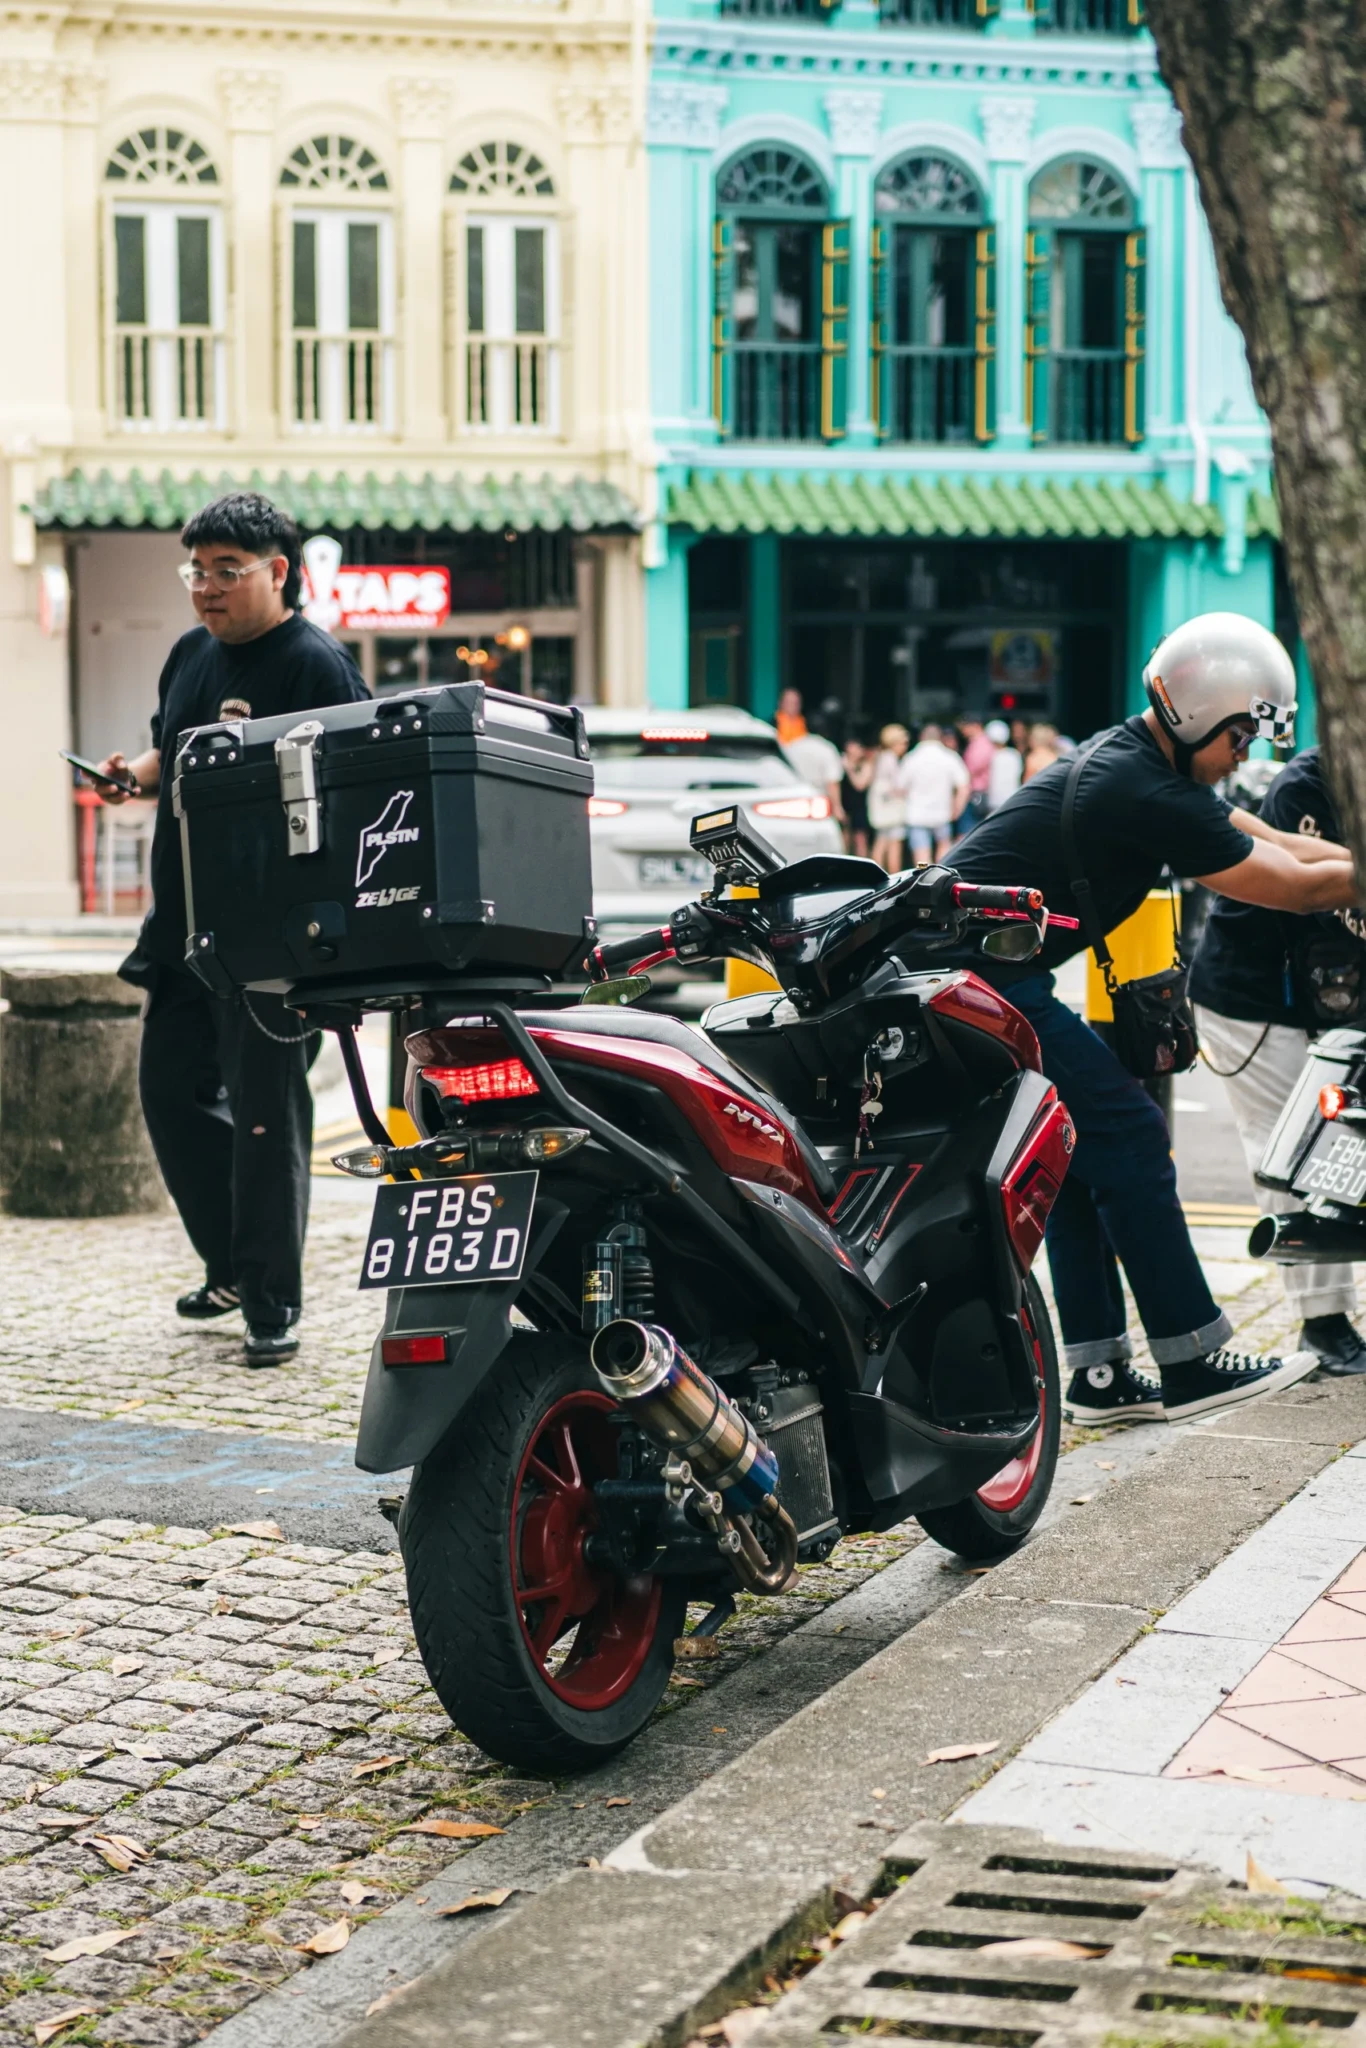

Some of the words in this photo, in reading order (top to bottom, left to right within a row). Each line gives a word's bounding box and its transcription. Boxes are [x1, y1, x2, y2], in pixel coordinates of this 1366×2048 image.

[366, 828, 419, 848] PLSTN
[723, 1102, 785, 1146] NVX
[1327, 1133, 1366, 1168] FBH
[407, 1184, 496, 1232] FBS
